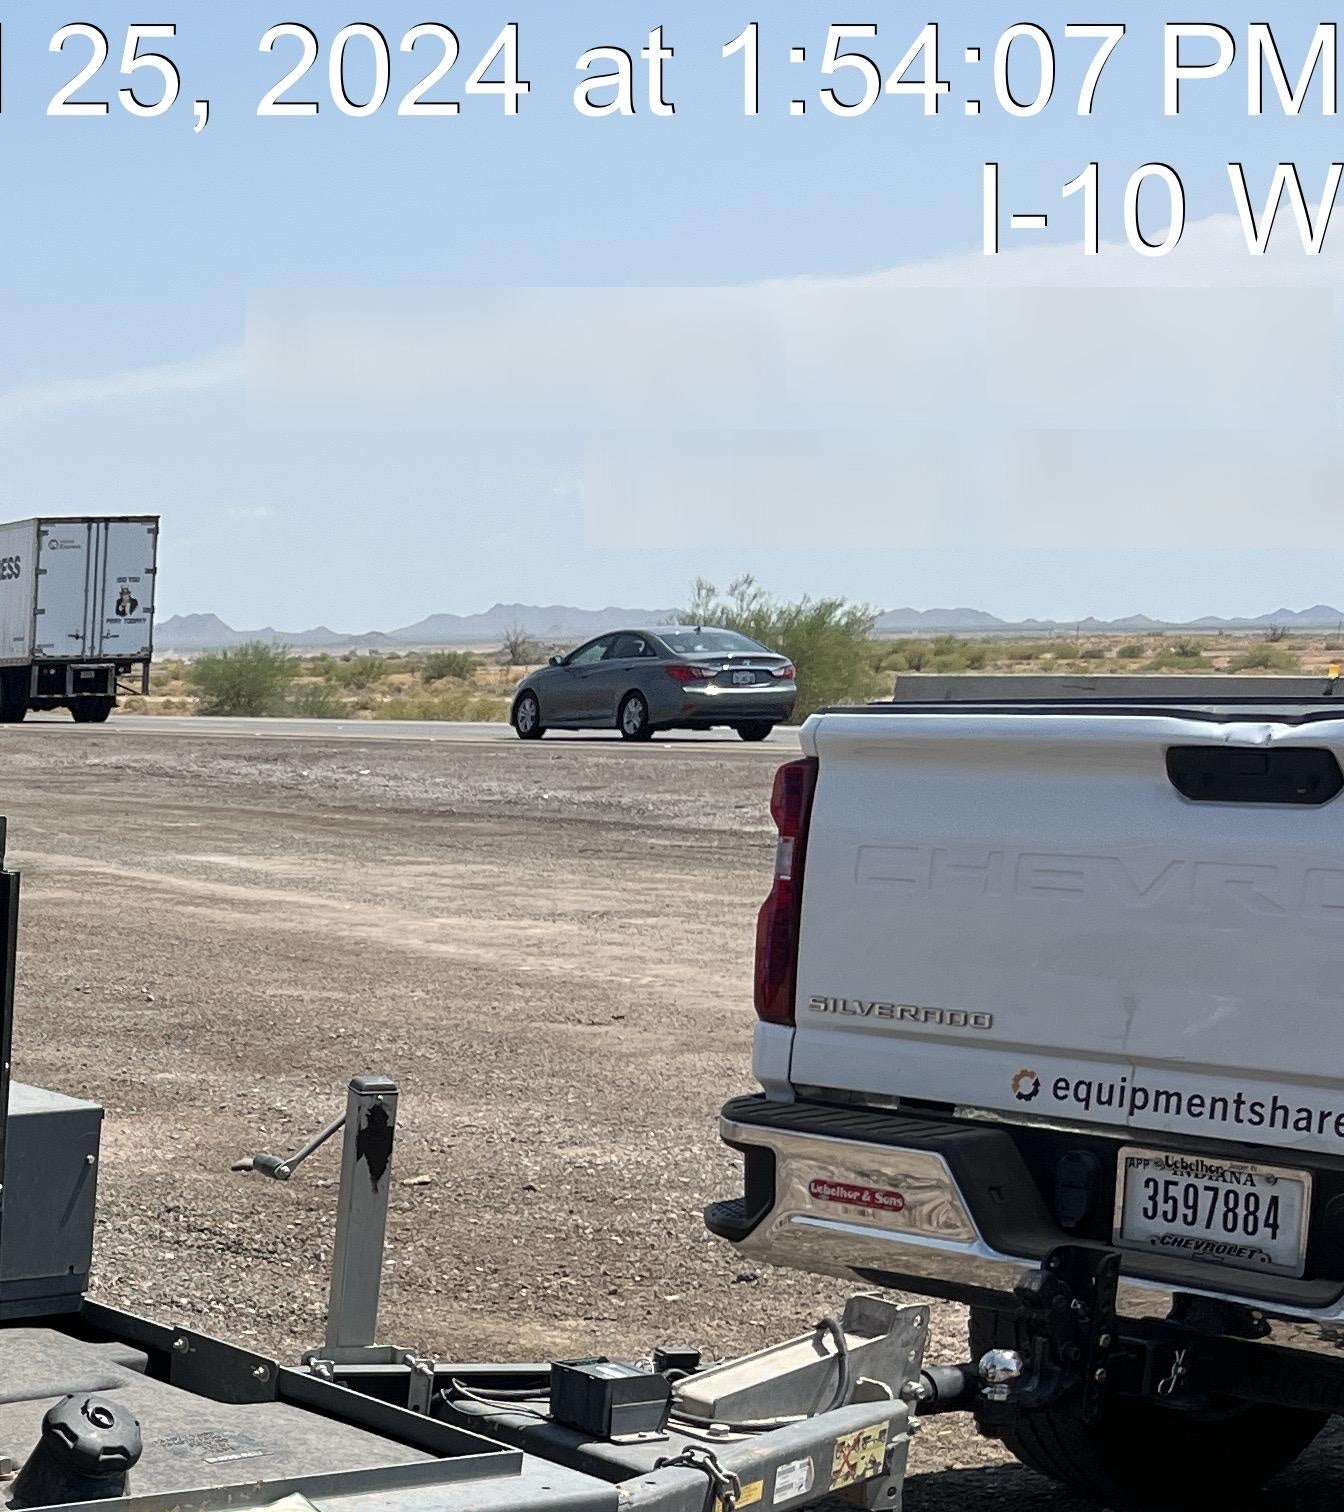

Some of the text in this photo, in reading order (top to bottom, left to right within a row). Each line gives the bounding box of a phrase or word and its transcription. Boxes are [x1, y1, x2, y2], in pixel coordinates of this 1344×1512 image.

[808, 996, 994, 1029] SILVERADO
[1052, 1075, 1344, 1138] equipmentshare
[861, 1190, 871, 1202] &
[874, 1192, 903, 1207] Sons
[1142, 1177, 1280, 1240] 3597884
[1159, 1234, 1259, 1259] CHEVROLET
